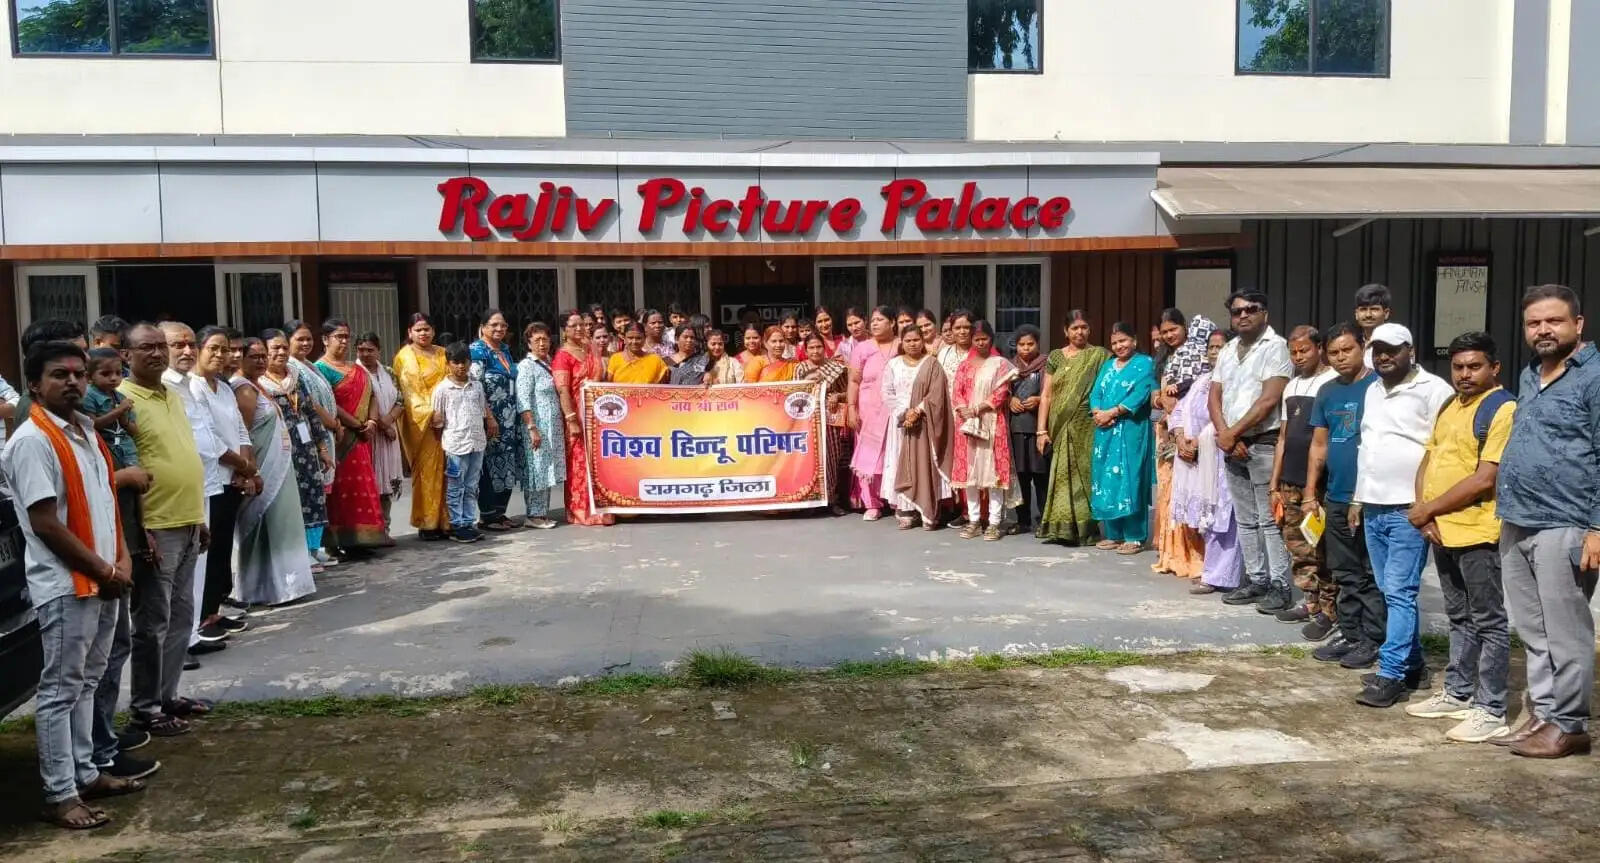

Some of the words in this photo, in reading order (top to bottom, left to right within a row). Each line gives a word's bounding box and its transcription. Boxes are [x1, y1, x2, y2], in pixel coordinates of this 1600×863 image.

[437, 176, 616, 241] Rajiv
[637, 177, 861, 234] Picture
[880, 178, 1071, 233] Palace
[602, 429, 661, 458] विश्व
[671, 429, 735, 464] हिन्दू
[736, 427, 808, 455] परिषद
[644, 483, 714, 498] रामगढ़
[720, 479, 770, 494] जिला
